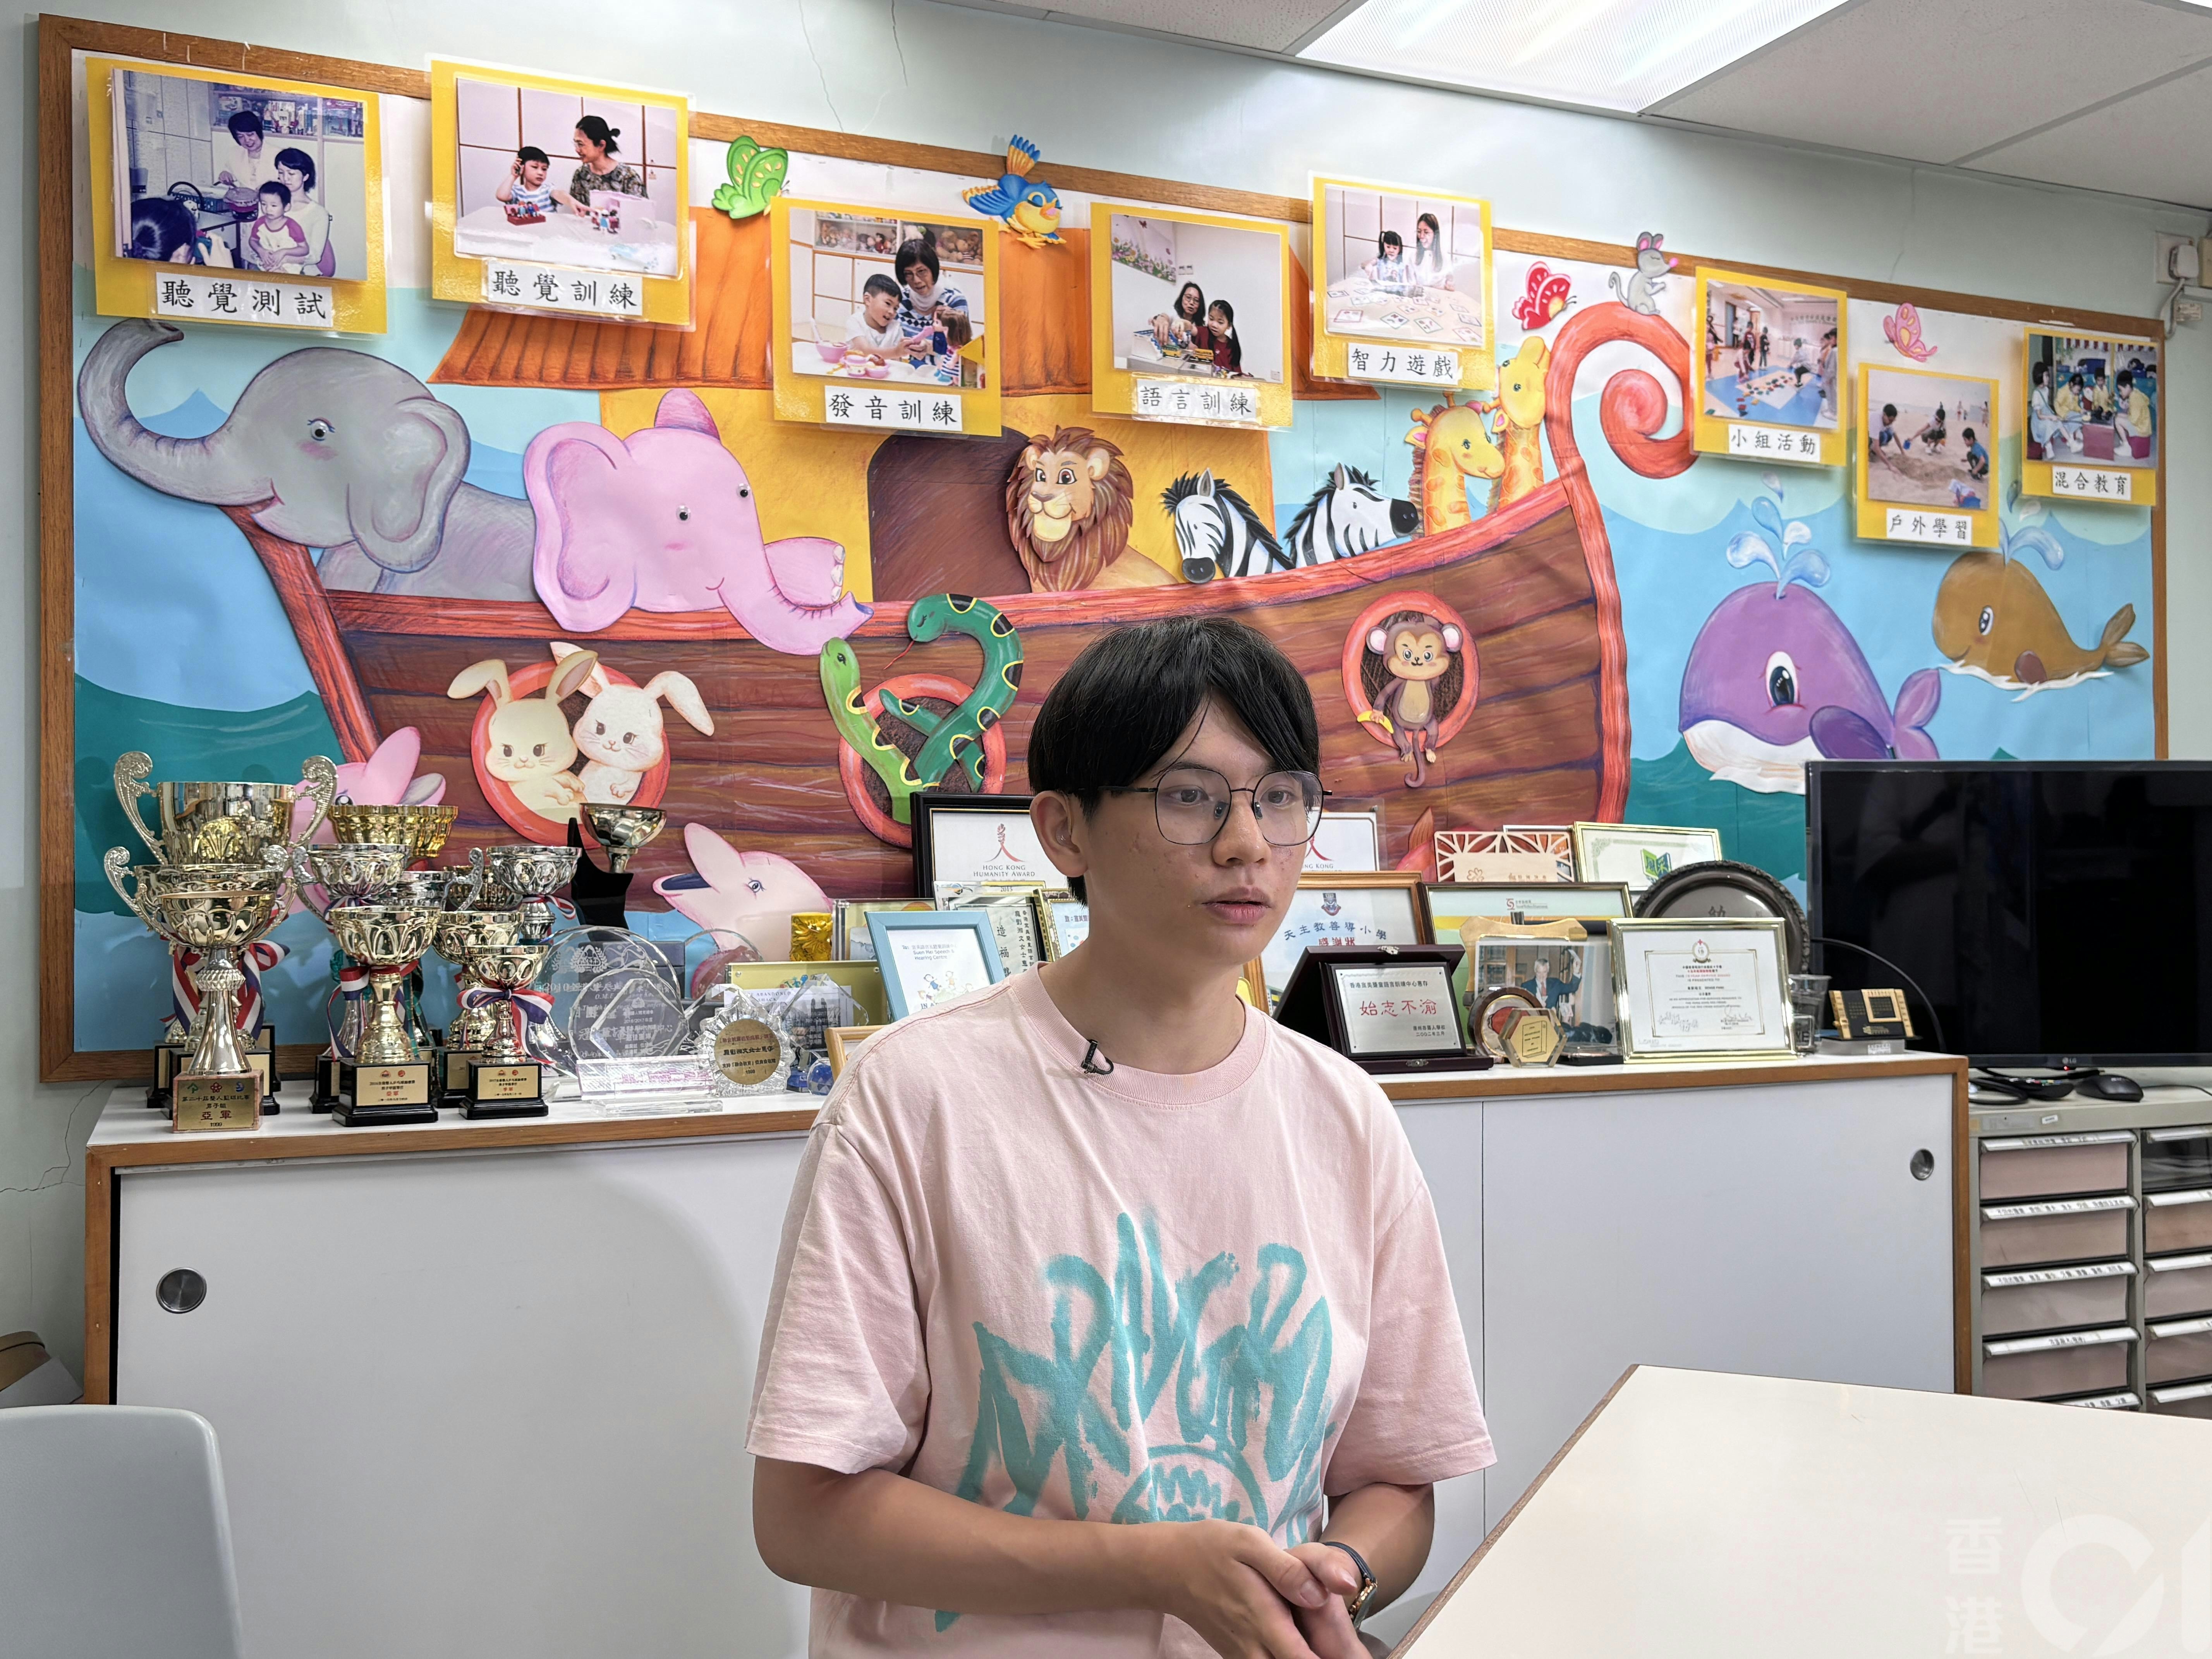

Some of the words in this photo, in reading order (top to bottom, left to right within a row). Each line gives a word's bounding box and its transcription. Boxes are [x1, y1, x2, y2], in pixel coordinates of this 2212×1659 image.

[161, 279, 326, 319] 聽覺測試
[493, 270, 637, 310] 聽覺訓練
[1351, 348, 1453, 379] 智力遊戲
[828, 393, 958, 426] 發音訓練
[1140, 386, 1252, 416] 語言訓練
[1731, 429, 1815, 455] 小組活動
[2055, 471, 2128, 495] 混合教育
[1889, 514, 1967, 540] 戶外學習
[1284, 921, 1386, 940] 天主教善導小學
[1359, 998, 1436, 1017] 始志不渝
[201, 1110, 232, 1120] 亞軍
